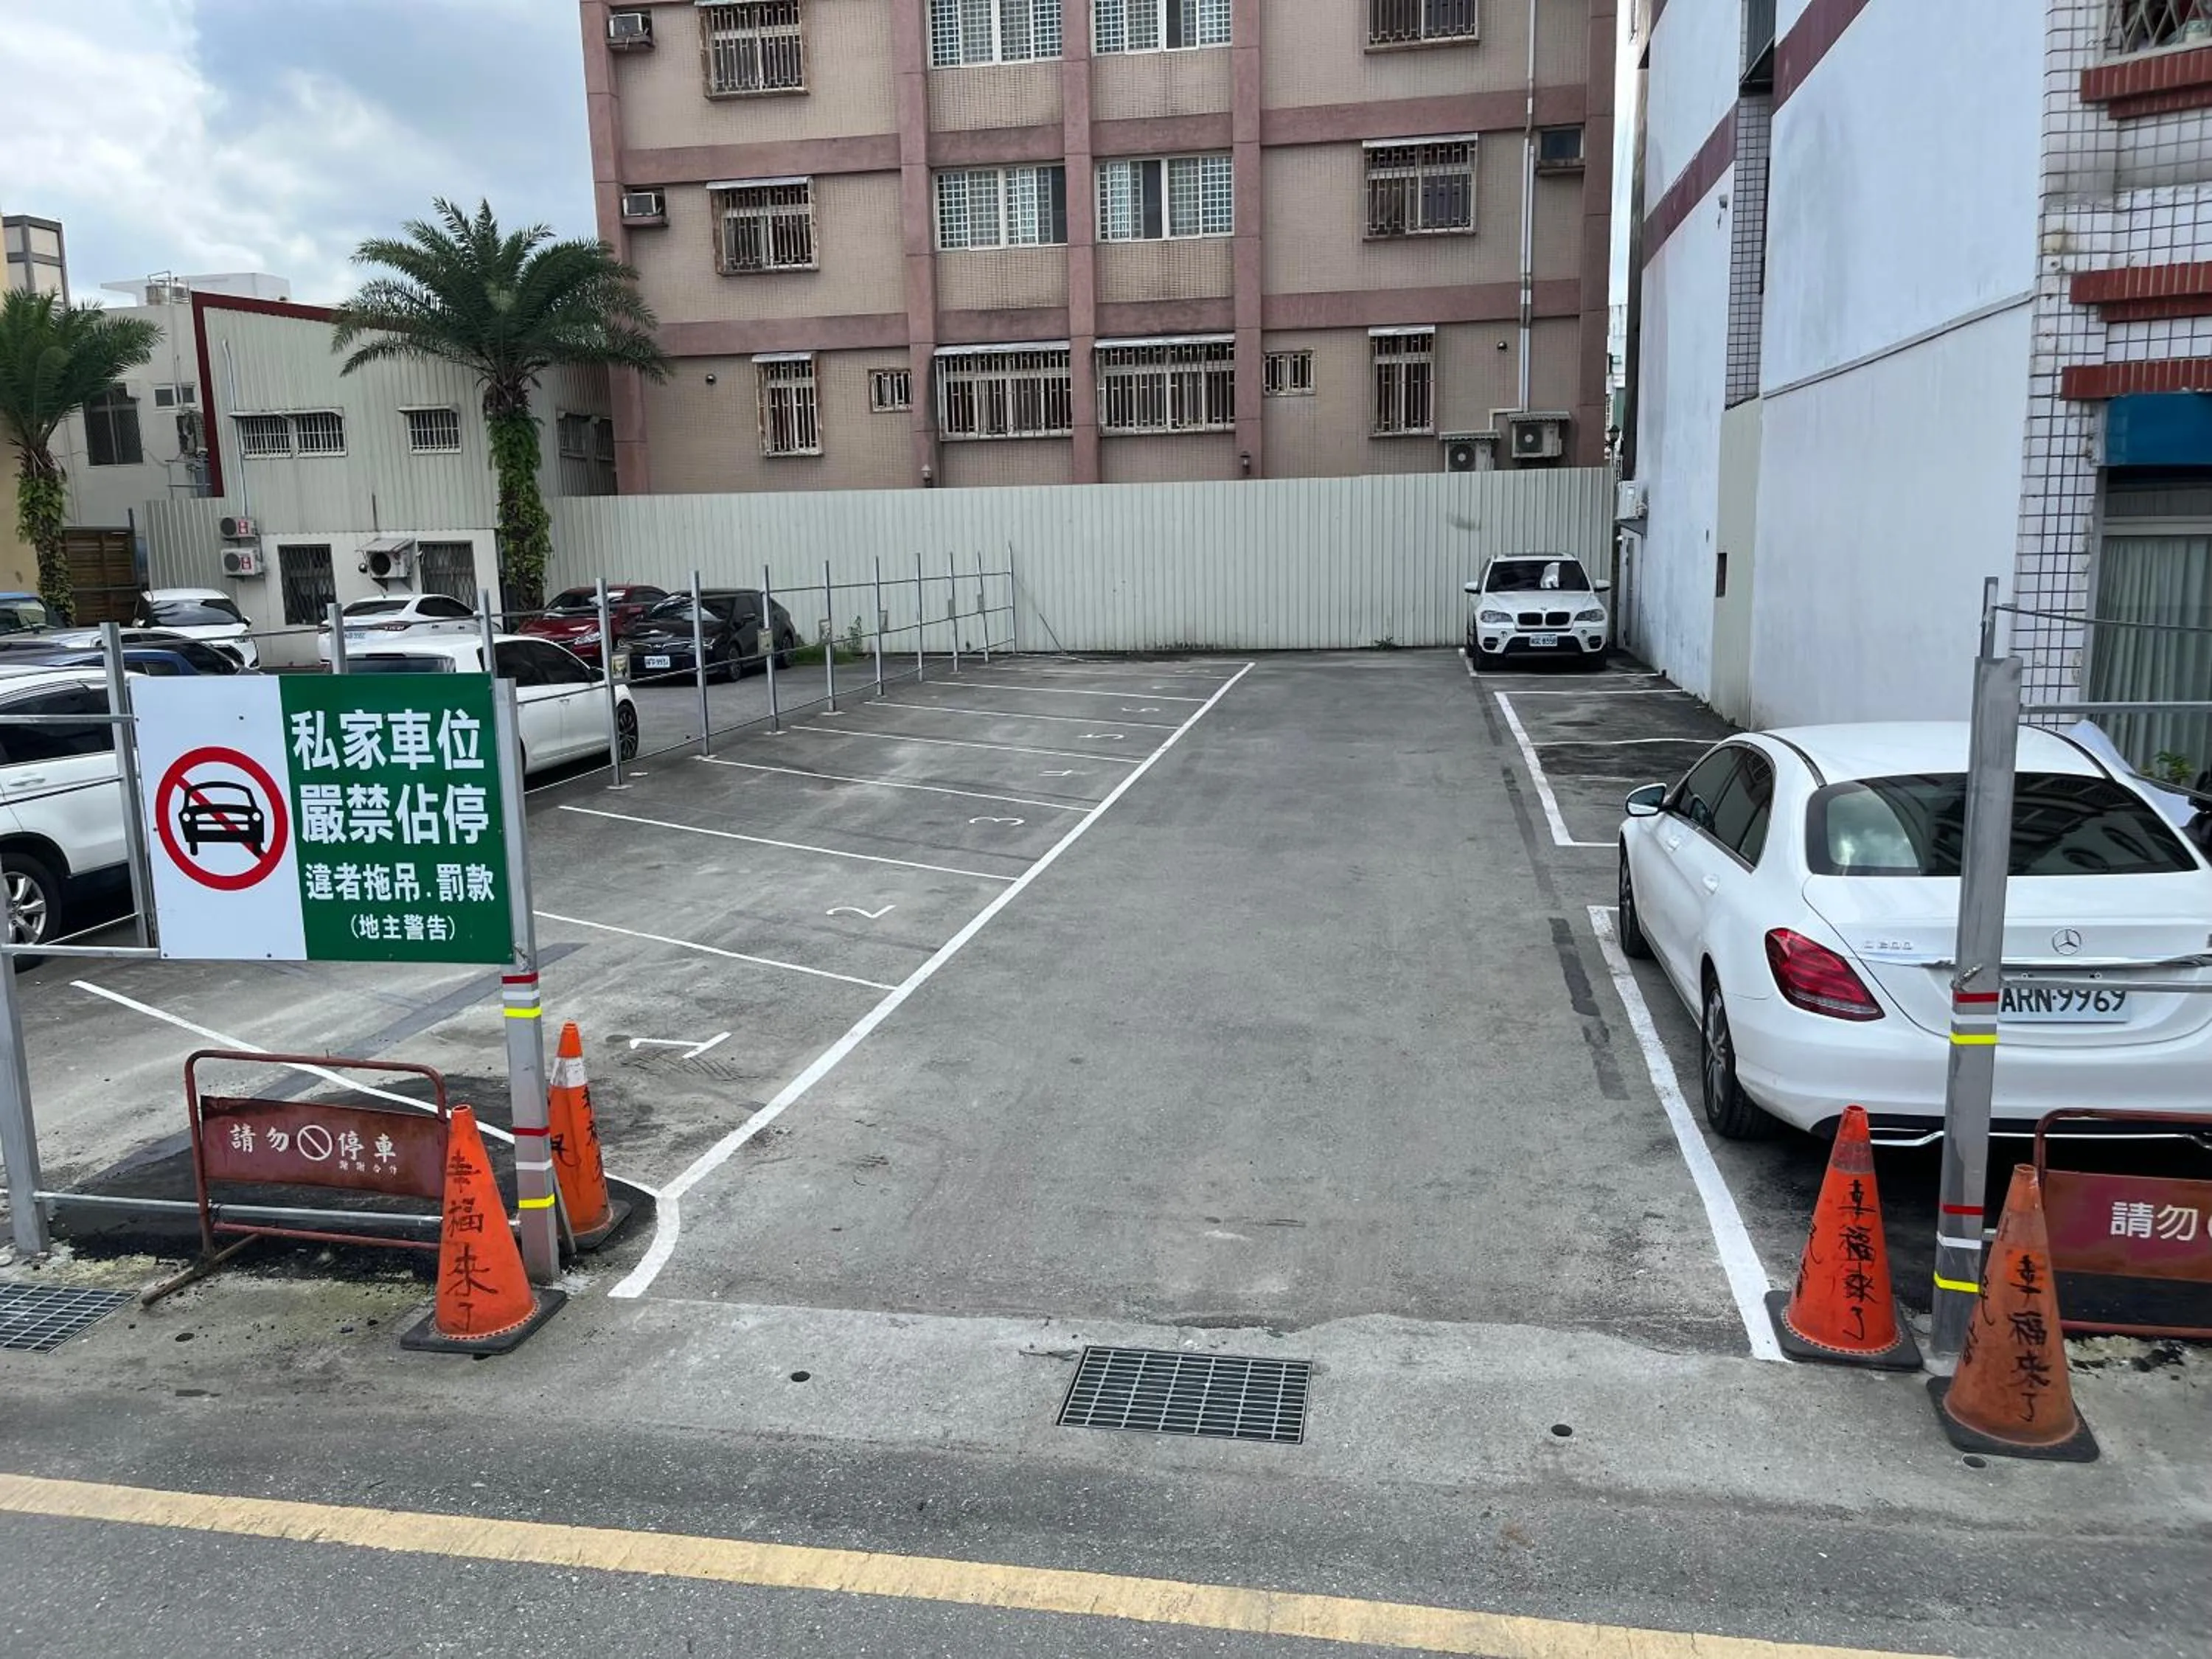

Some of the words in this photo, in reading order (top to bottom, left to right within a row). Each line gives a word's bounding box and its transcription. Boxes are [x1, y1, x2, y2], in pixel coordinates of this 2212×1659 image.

[290, 709, 485, 771] 私家車位
[299, 783, 490, 844] 嚴禁佔停
[968, 815, 1025, 827] 3
[350, 914, 455, 941] (地主警告)
[825, 904, 897, 919] 2
[629, 1032, 732, 1060] 1
[229, 1123, 290, 1153] 請勿
[337, 1130, 397, 1164] 停車
[2110, 1201, 2199, 1242] 請勿
